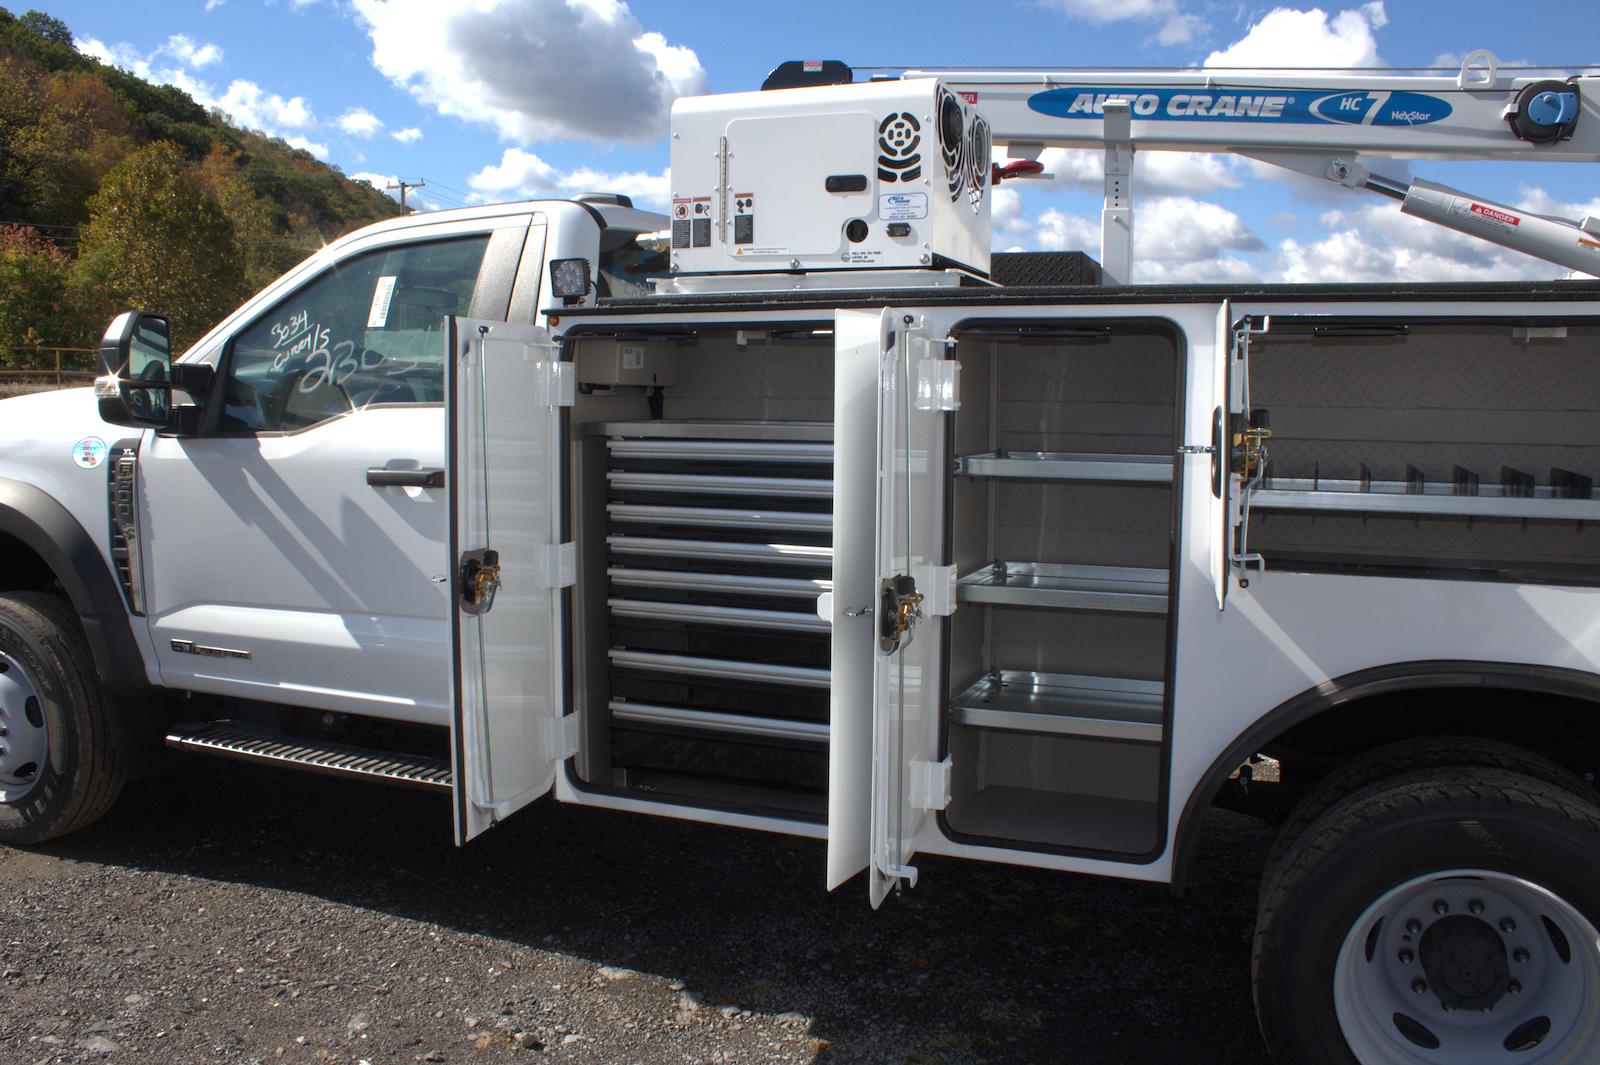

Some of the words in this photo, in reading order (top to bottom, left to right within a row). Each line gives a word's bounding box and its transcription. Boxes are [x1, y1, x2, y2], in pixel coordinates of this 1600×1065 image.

[1166, 95, 1287, 117] CRANE
[1340, 97, 1362, 111] HC
[1361, 91, 1392, 125] 7
[1483, 208, 1515, 223] DANGER
[271, 310, 308, 348] 3034
